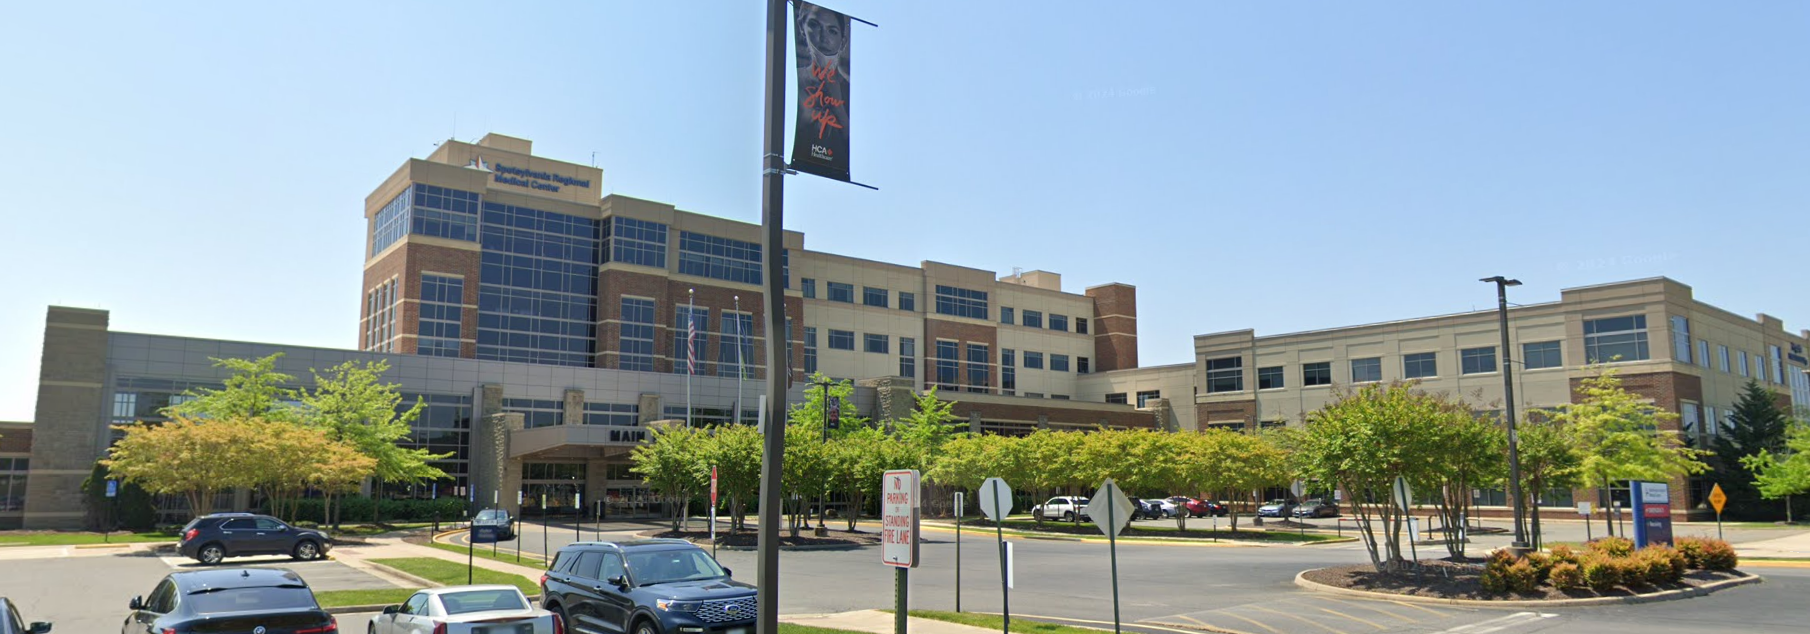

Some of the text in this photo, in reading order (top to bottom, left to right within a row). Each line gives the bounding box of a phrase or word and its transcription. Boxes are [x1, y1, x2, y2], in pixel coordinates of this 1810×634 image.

[811, 59, 836, 83] We
[811, 108, 843, 139] up
[811, 144, 828, 155] HCA
[495, 163, 590, 188] Spotsylvania Regional
[494, 174, 560, 192] Medical Center
[610, 429, 645, 442] MAIN
[893, 478, 902, 490] NO
[887, 492, 909, 505] PARKING
[885, 515, 910, 528] STANDING
[884, 529, 910, 545] FIRE LANE
